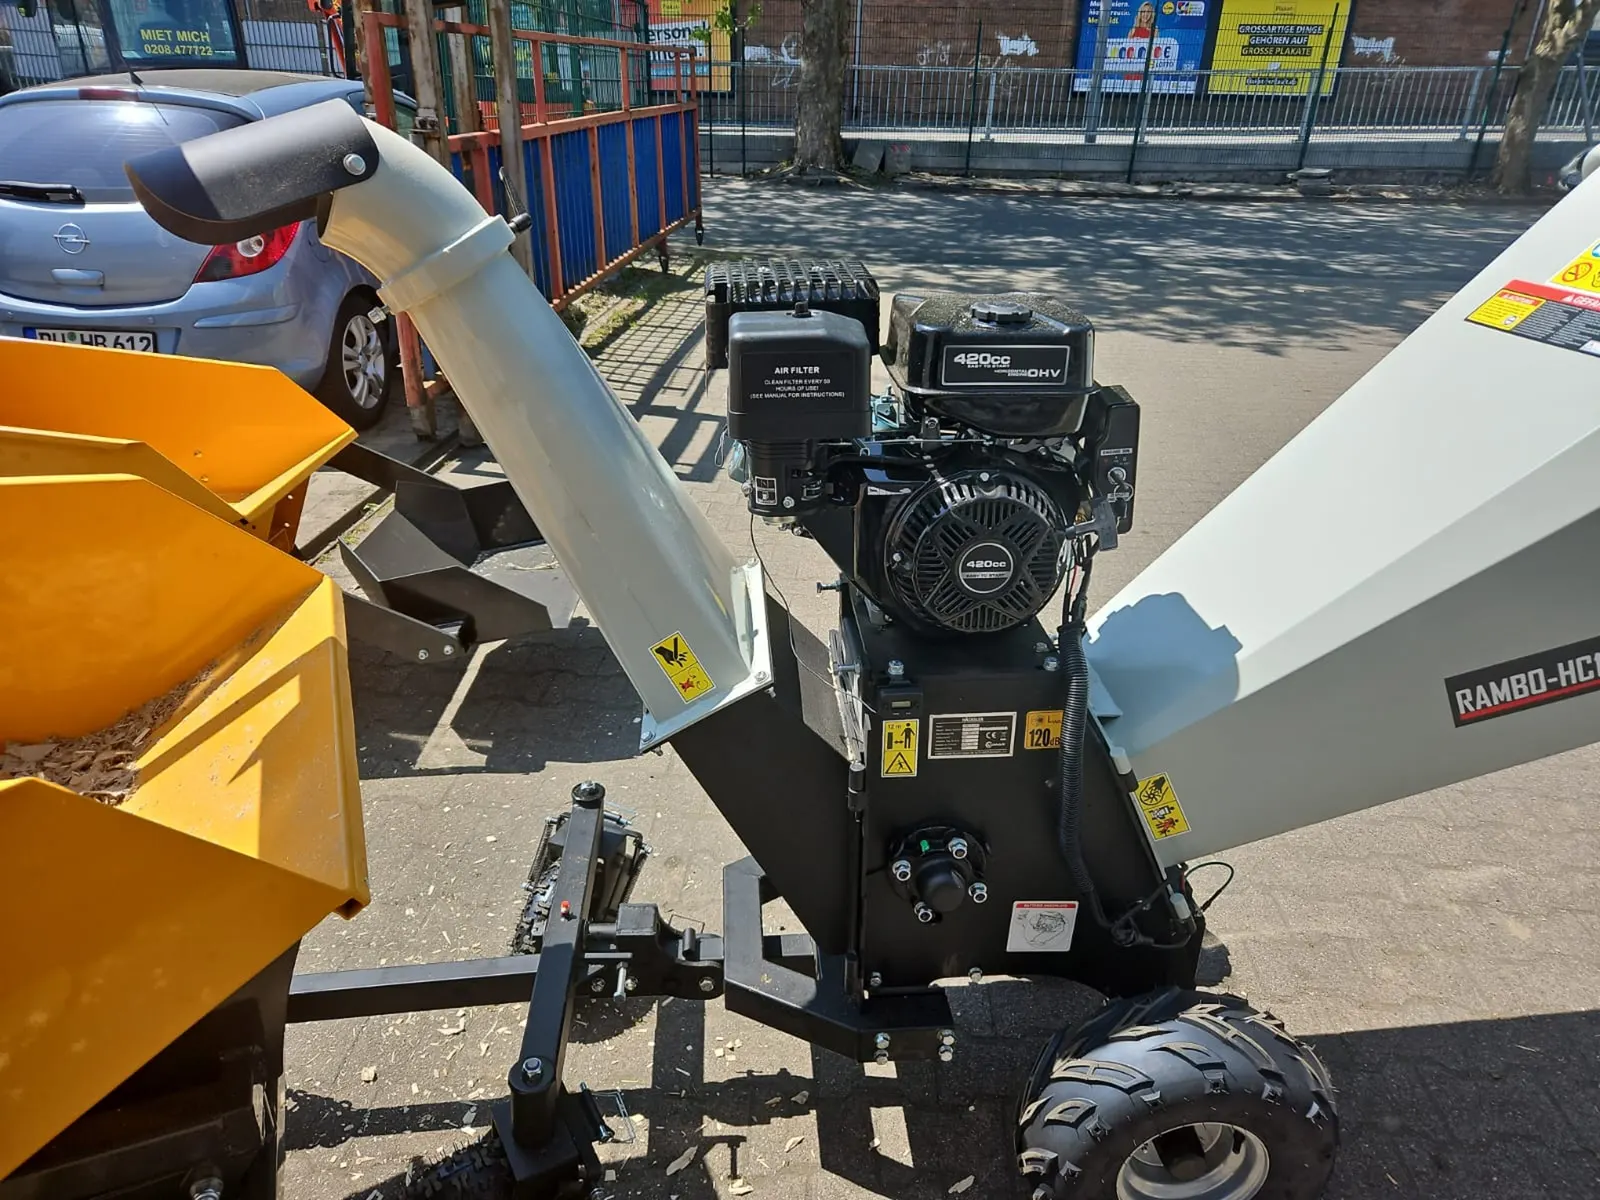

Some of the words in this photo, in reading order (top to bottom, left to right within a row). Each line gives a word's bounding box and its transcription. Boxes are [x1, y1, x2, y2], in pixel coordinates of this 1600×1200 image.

[1239, 25, 1294, 34] GROSSARTIGE
[1296, 25, 1322, 34] DINGE
[140, 29, 172, 41] MIET
[176, 30, 211, 42] MICH
[1249, 35, 1289, 45] GEHÖREN
[1290, 36, 1308, 45] AUF
[144, 43, 213, 56] 0208.477722
[1242, 47, 1273, 55] GROSSE
[1275, 47, 1311, 55] PLAKATE
[80, 333, 106, 348] HB
[114, 335, 151, 352] 612
[953, 353, 1011, 365] 420cc
[790, 366, 820, 374] FILTER
[1027, 368, 1061, 377] OHV
[966, 560, 1007, 568] 420cc
